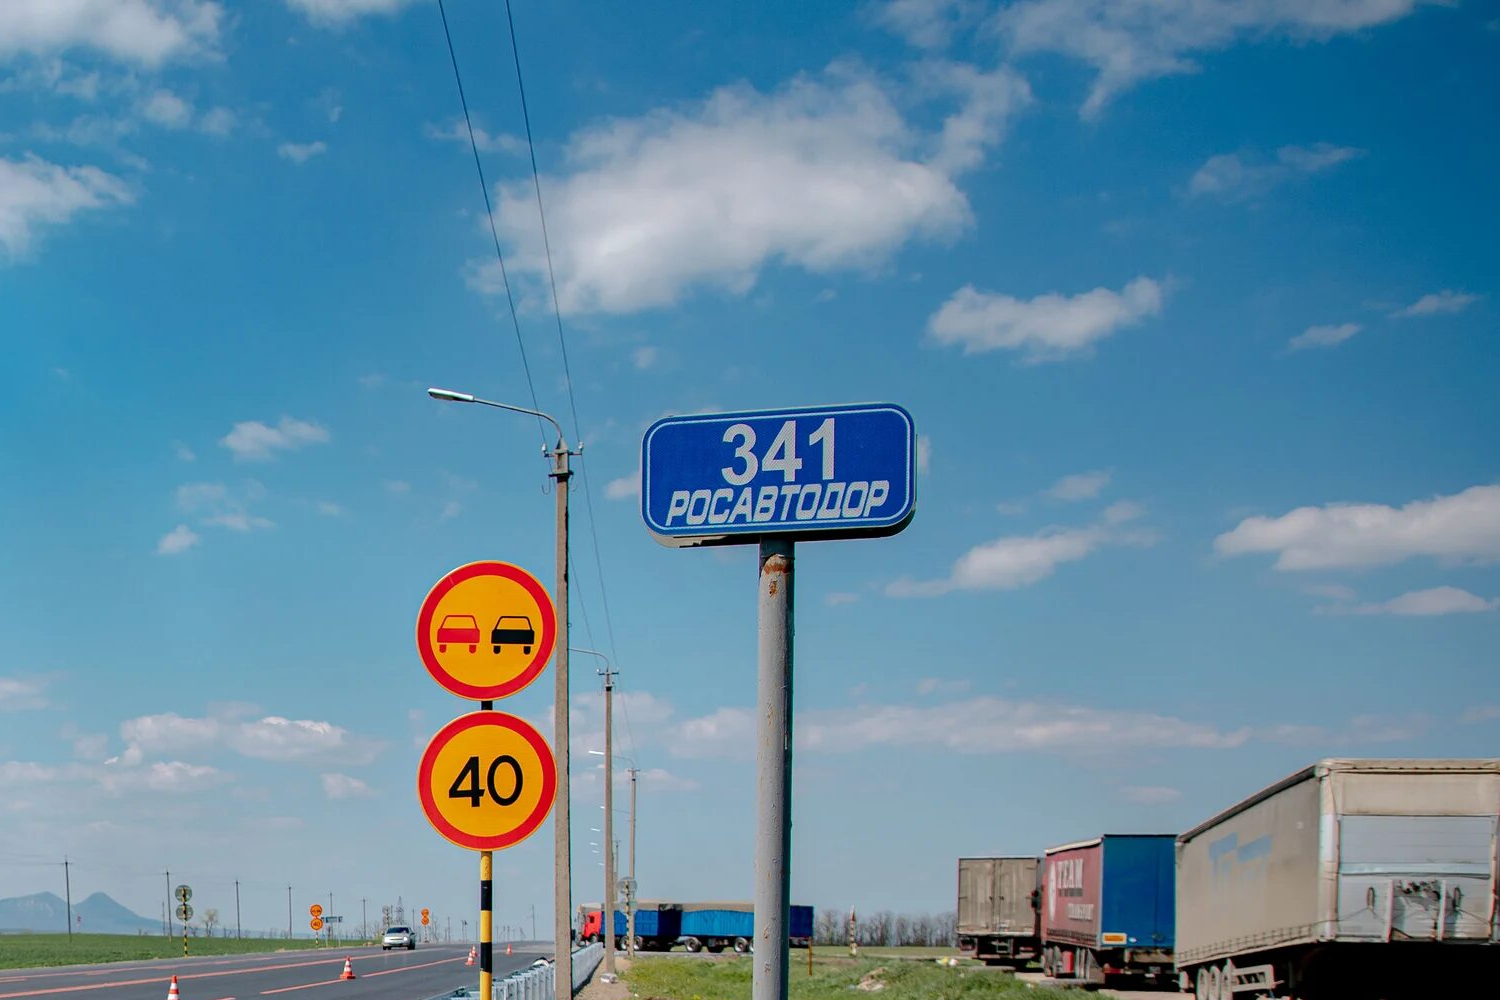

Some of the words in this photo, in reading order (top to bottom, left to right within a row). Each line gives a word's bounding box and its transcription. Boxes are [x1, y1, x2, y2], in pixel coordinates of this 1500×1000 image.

[721, 418, 835, 486] 341
[665, 480, 890, 526] РОСАВТОДОР
[448, 754, 524, 808] 40
